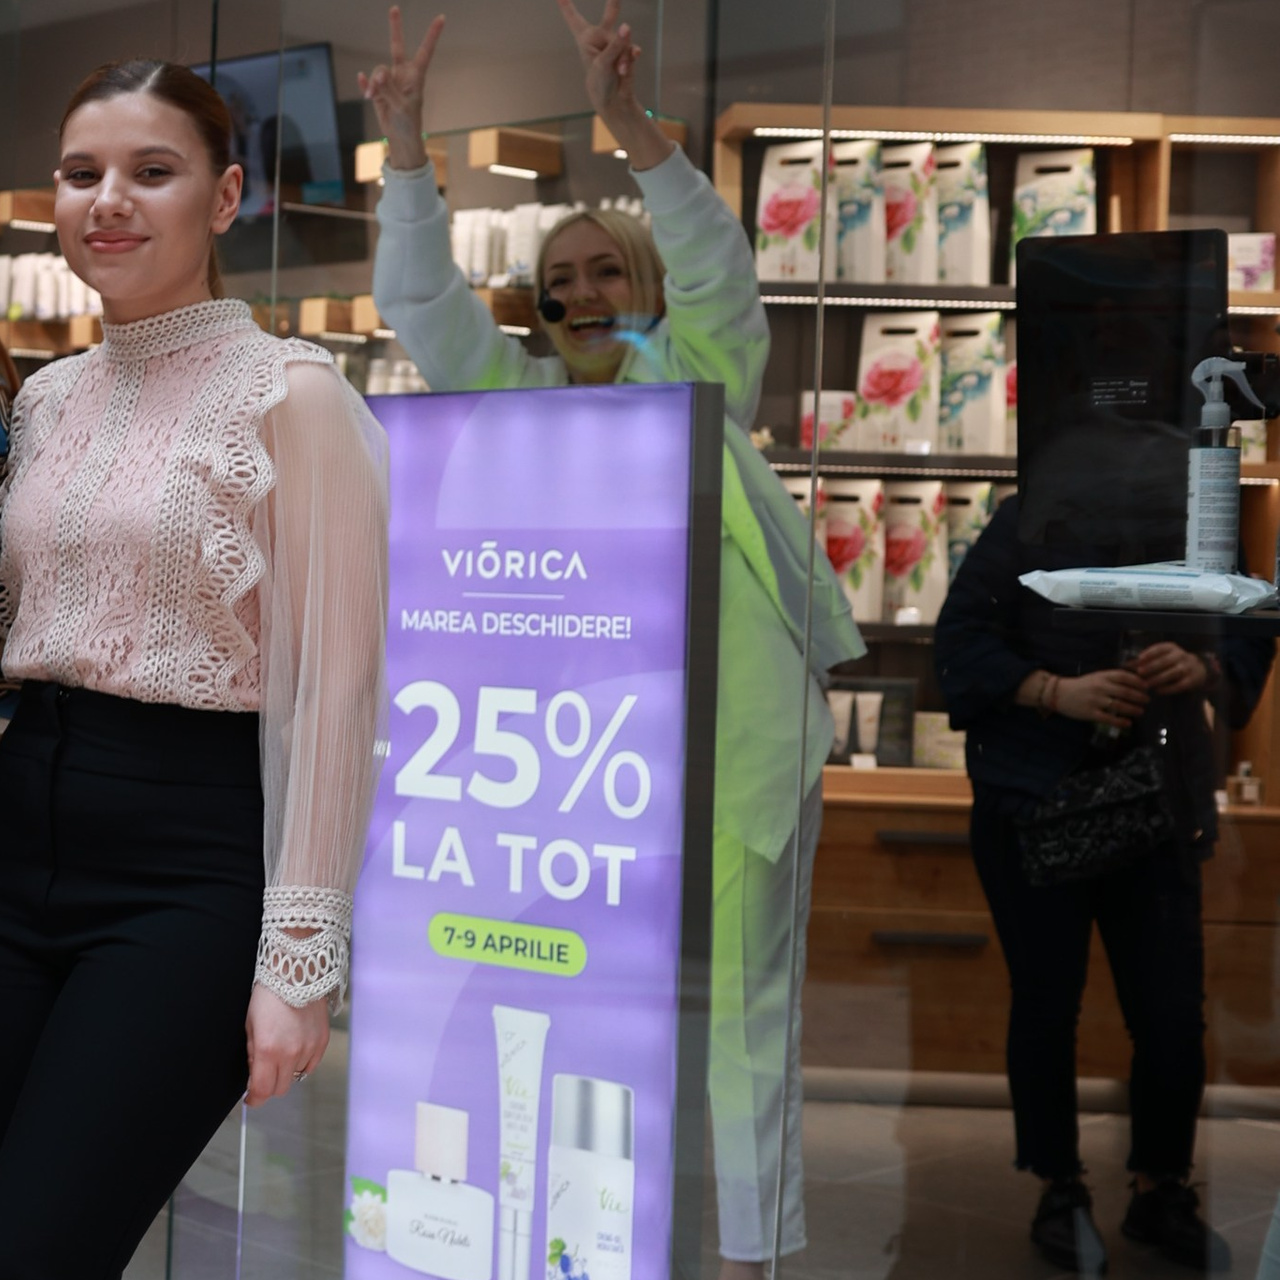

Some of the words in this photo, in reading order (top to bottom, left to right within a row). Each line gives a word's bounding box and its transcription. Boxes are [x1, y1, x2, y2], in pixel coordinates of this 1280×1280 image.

[401, 609, 477, 634] MAREA
[482, 612, 632, 640] DESCHIDERE!
[393, 680, 651, 819] 25%
[392, 820, 475, 887] LA
[496, 832, 637, 906] TOT
[444, 926, 476, 949] 7-9
[482, 933, 569, 964] APRILIE
